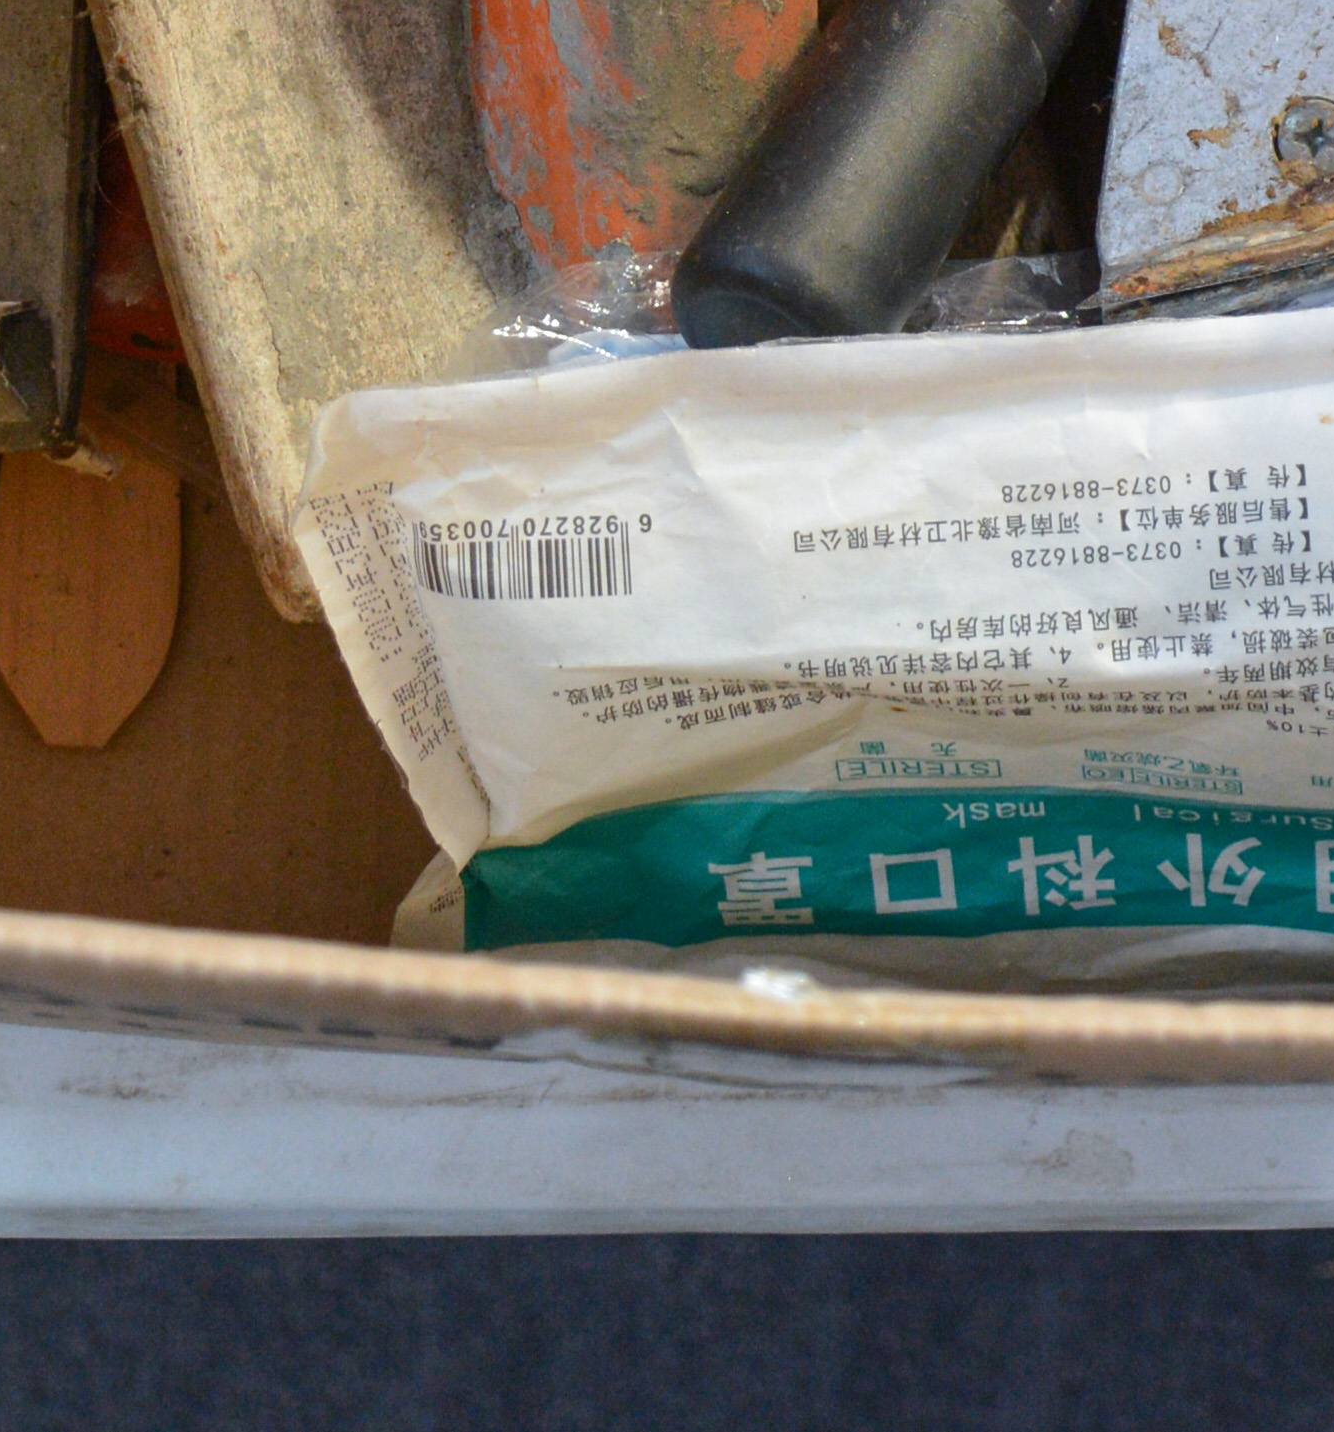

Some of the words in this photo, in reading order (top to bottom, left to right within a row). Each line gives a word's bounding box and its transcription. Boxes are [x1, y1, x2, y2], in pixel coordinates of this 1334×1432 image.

[419, 517, 510, 546] 700359
[523, 515, 620, 536] 928270
[638, 515, 653, 534] 6
[844, 758, 994, 781] STERILE
[1136, 767, 1235, 793] STERILE
[940, 800, 1046, 827] mask
[1130, 803, 1334, 832] Surgical
